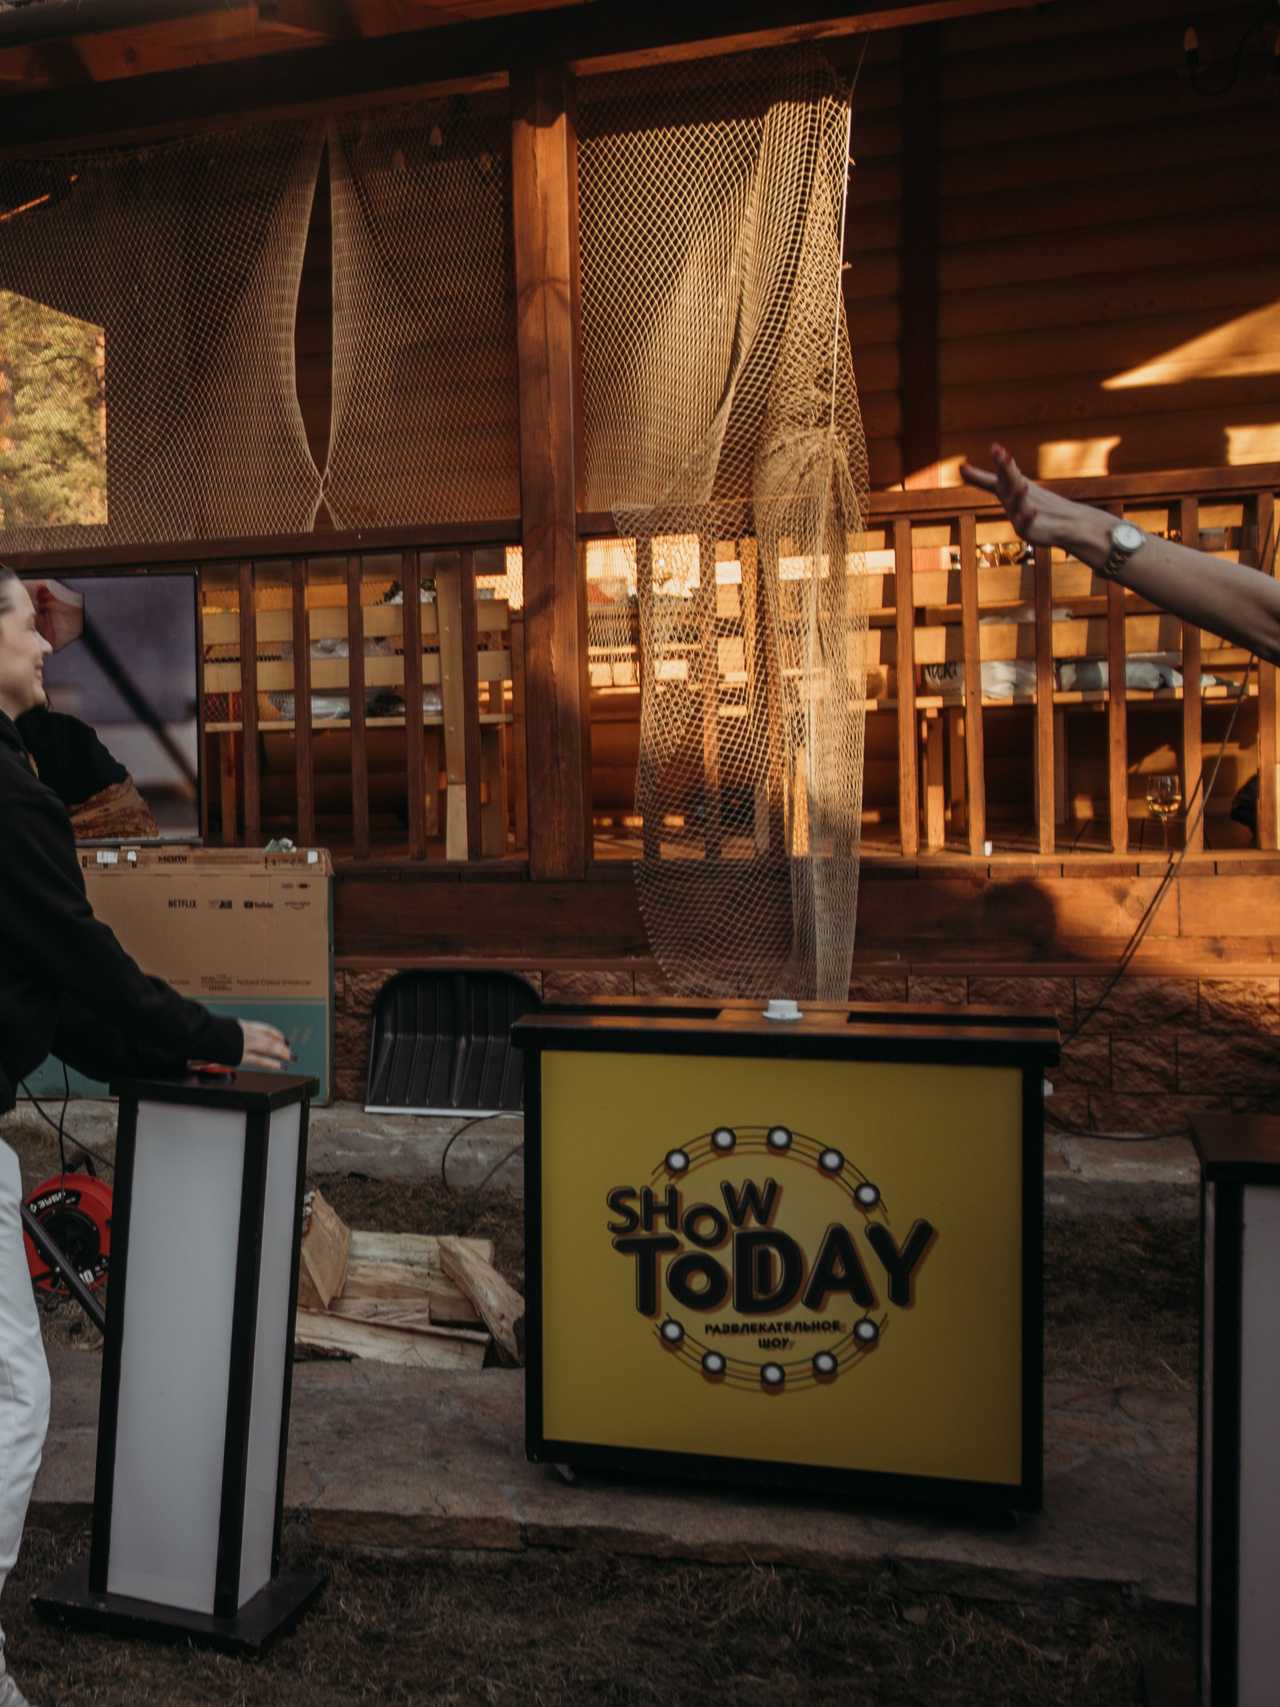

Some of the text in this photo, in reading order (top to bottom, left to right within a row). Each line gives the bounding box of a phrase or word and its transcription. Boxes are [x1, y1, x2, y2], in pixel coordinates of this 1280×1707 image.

[168, 899, 197, 909] NETFLIX
[705, 1319, 842, 1337] РАЗВЛЕКАТЕЛЬНОЕ
[758, 1337, 792, 1350] ШОУ
